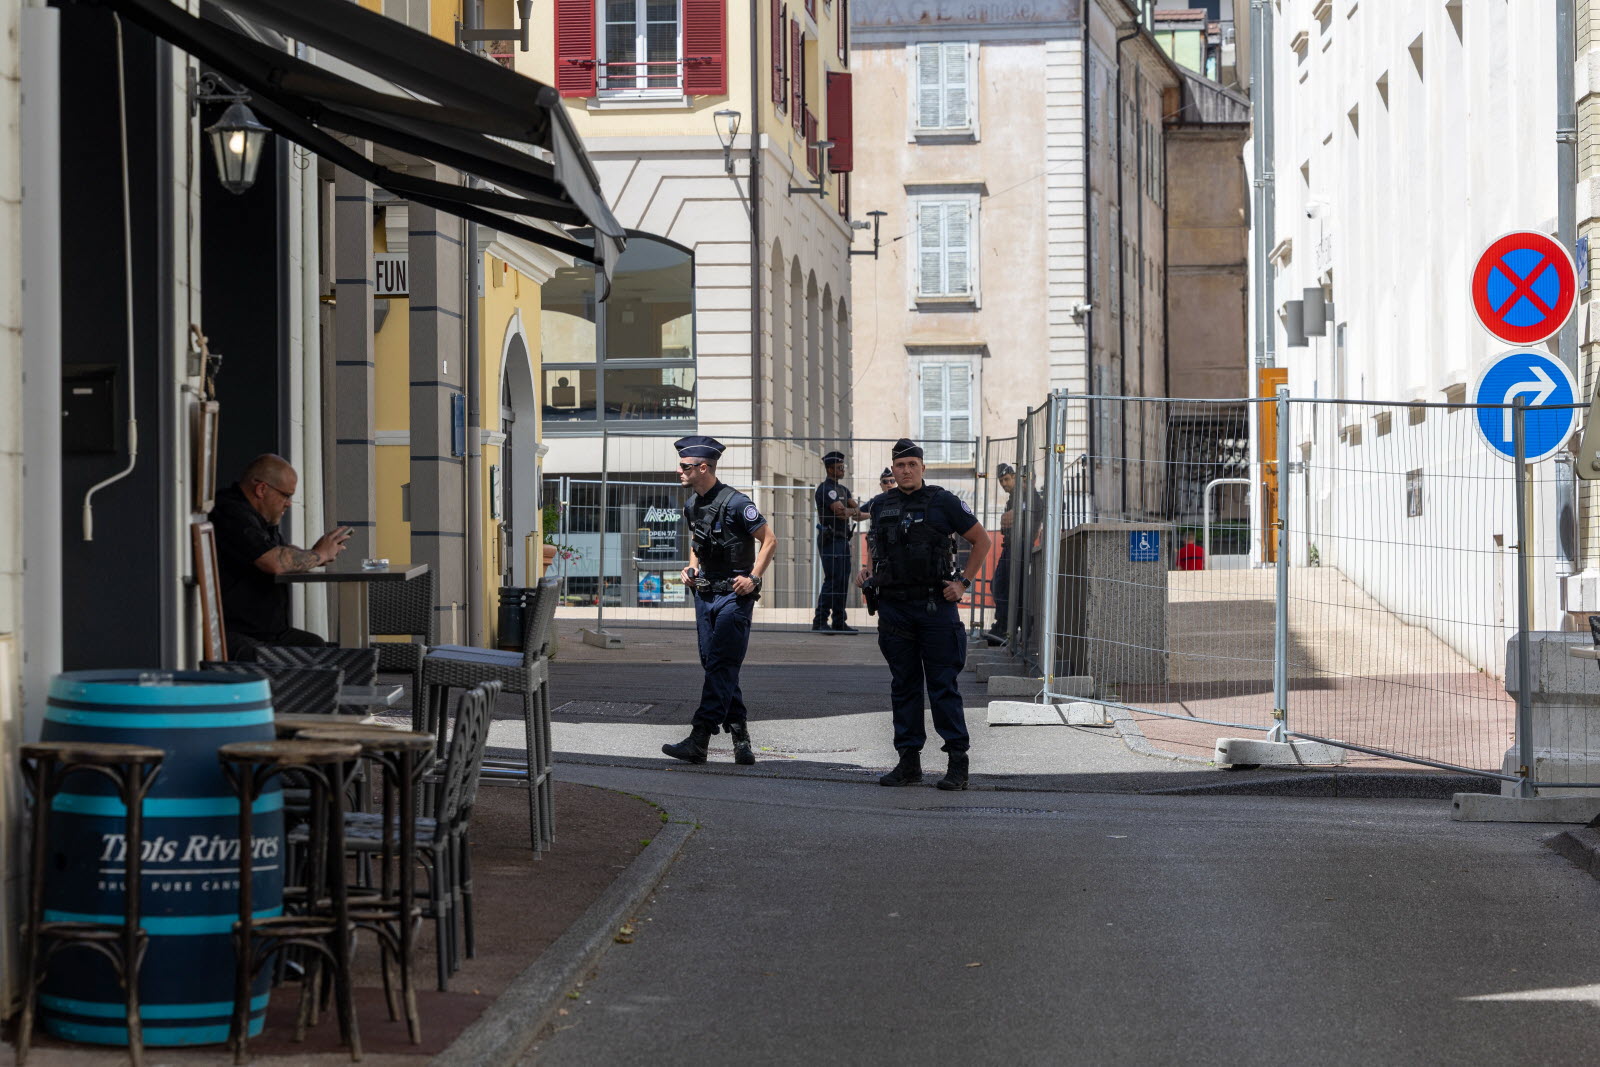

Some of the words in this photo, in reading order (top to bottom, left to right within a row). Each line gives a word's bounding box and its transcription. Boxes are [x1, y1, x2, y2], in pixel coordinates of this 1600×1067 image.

[375, 260, 406, 292] FUN
[658, 514, 681, 522] CAMP
[180, 834, 279, 862] Rivires
[151, 881, 192, 892] PURE
